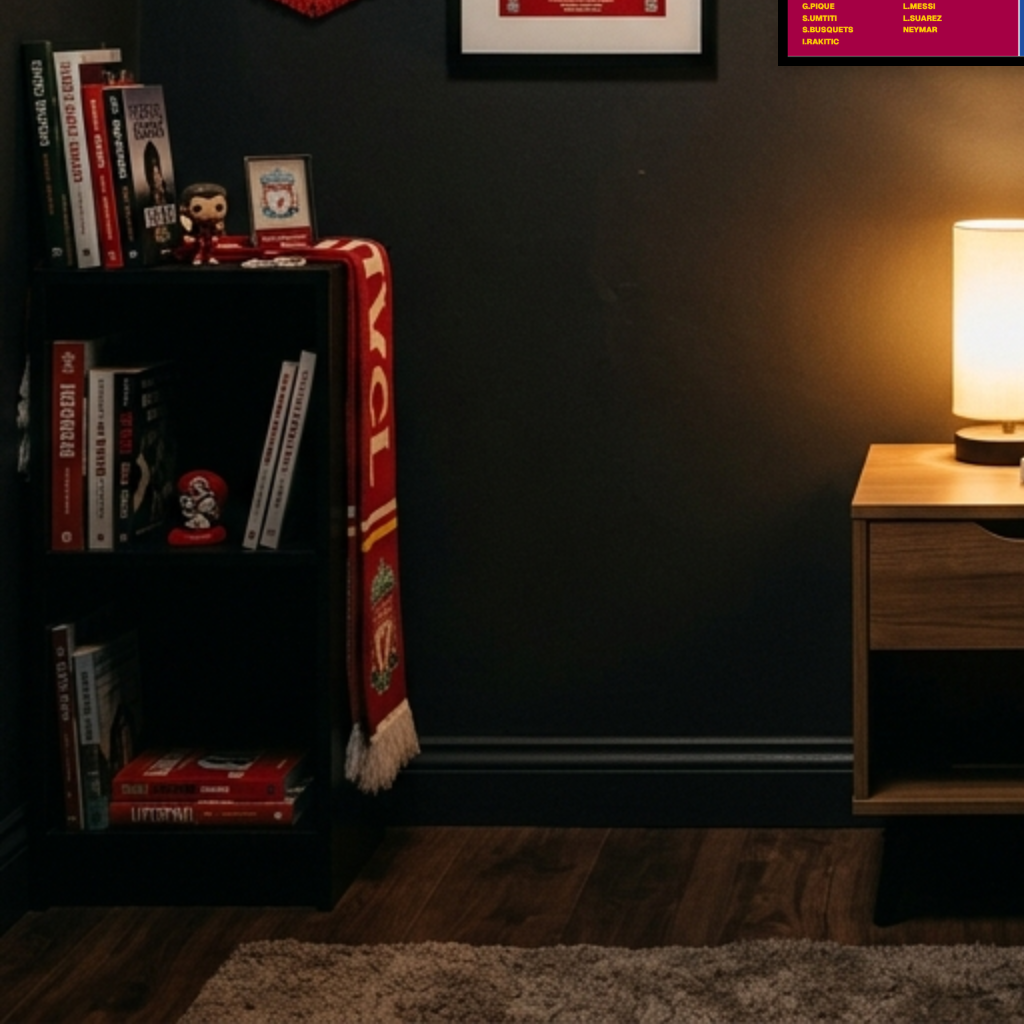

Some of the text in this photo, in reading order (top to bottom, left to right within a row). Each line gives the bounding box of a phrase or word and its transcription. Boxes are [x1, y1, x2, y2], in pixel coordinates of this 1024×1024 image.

[801, 2, 836, 11] G.PIQUE
[902, 2, 936, 10] L.MESSI
[801, 14, 838, 22] S.UMTITI
[902, 14, 943, 22] L.SUAREZ
[801, 25, 854, 34] S.BUSQUETS
[902, 26, 938, 34] NEYMAR
[801, 37, 840, 46] I.RAKITIC
